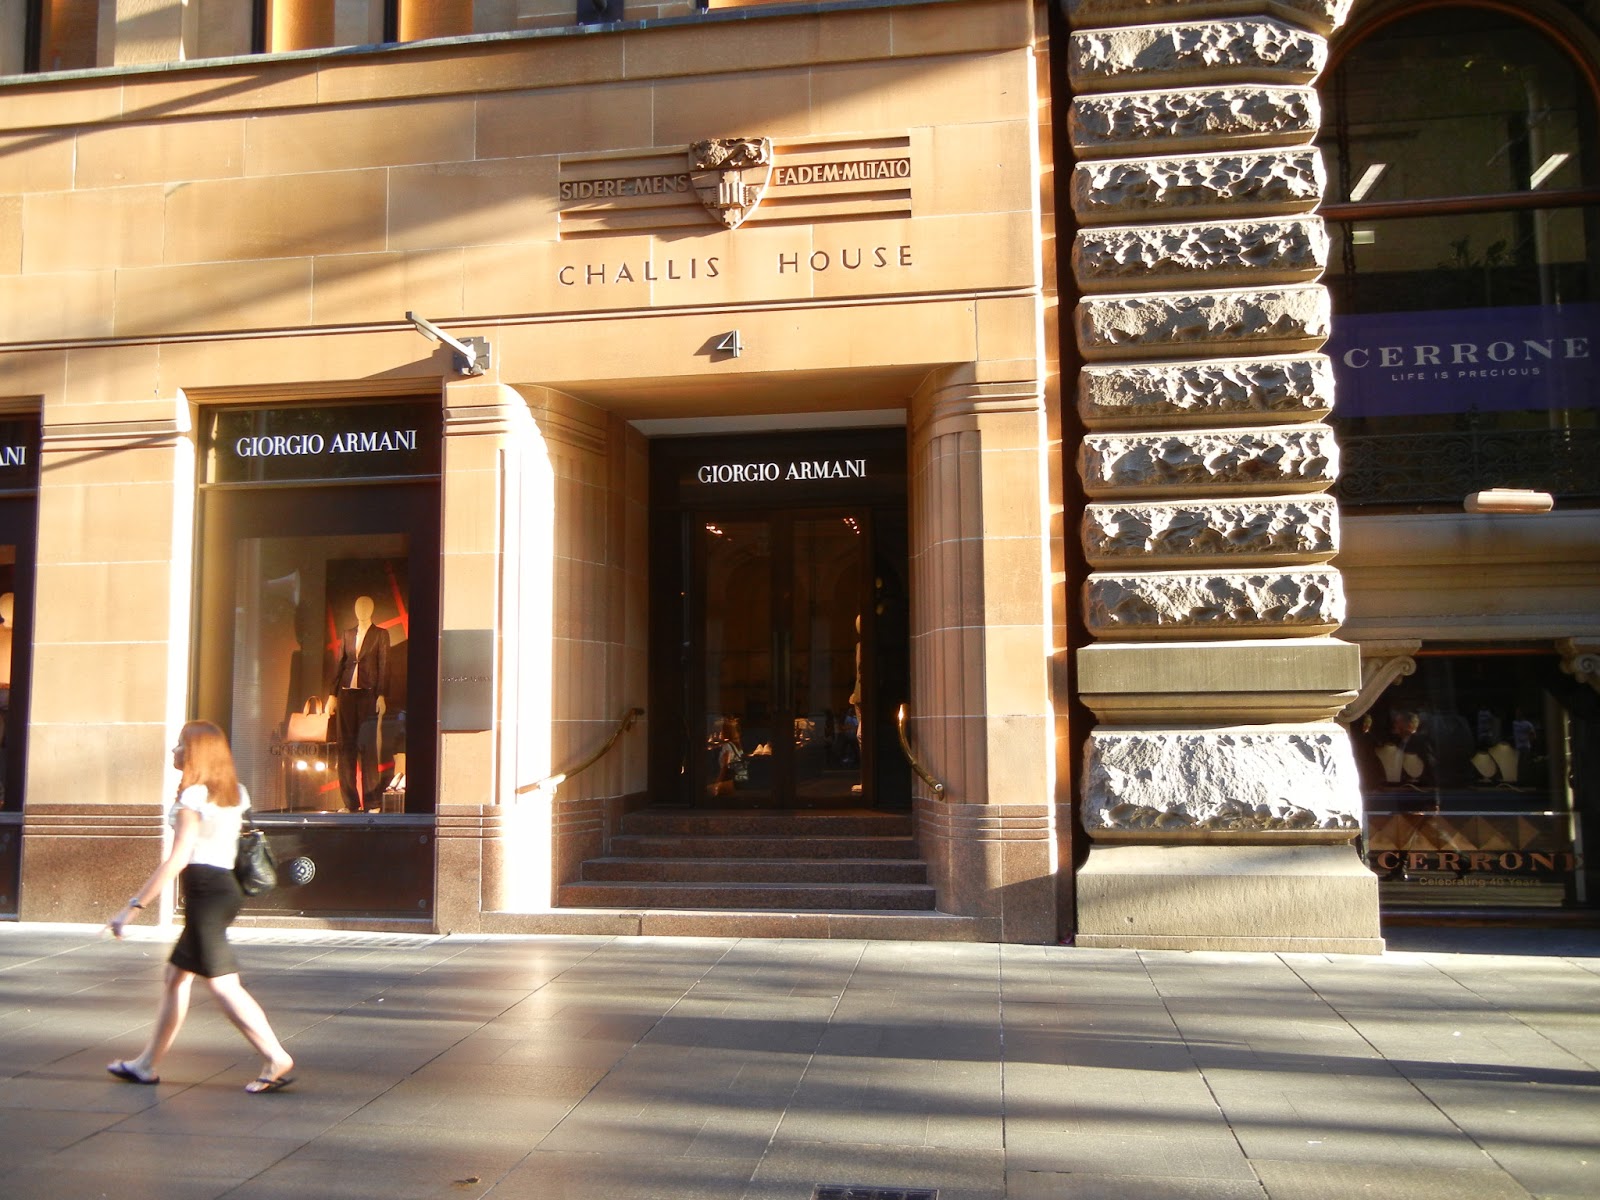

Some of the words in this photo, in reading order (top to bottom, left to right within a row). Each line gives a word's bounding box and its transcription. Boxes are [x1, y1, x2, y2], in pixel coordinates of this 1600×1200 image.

[560, 179, 627, 200] SIDERE
[634, 174, 690, 197] MENS
[559, 257, 720, 286] CHALLIS
[779, 245, 913, 274] HOUSE
[716, 329, 744, 358] 4
[1343, 337, 1590, 369] CERRONE
[1391, 372, 1426, 381] LIFE
[1434, 371, 1449, 379] IS
[1458, 367, 1541, 379] PRECIOUS
[235, 433, 325, 458] GIORGIO
[329, 429, 418, 454] ARMANI
[697, 462, 780, 483] GIORGIO
[785, 459, 867, 481] ARMANI
[1419, 877, 1486, 888] Celebrating
[1508, 877, 1541, 887] Years
